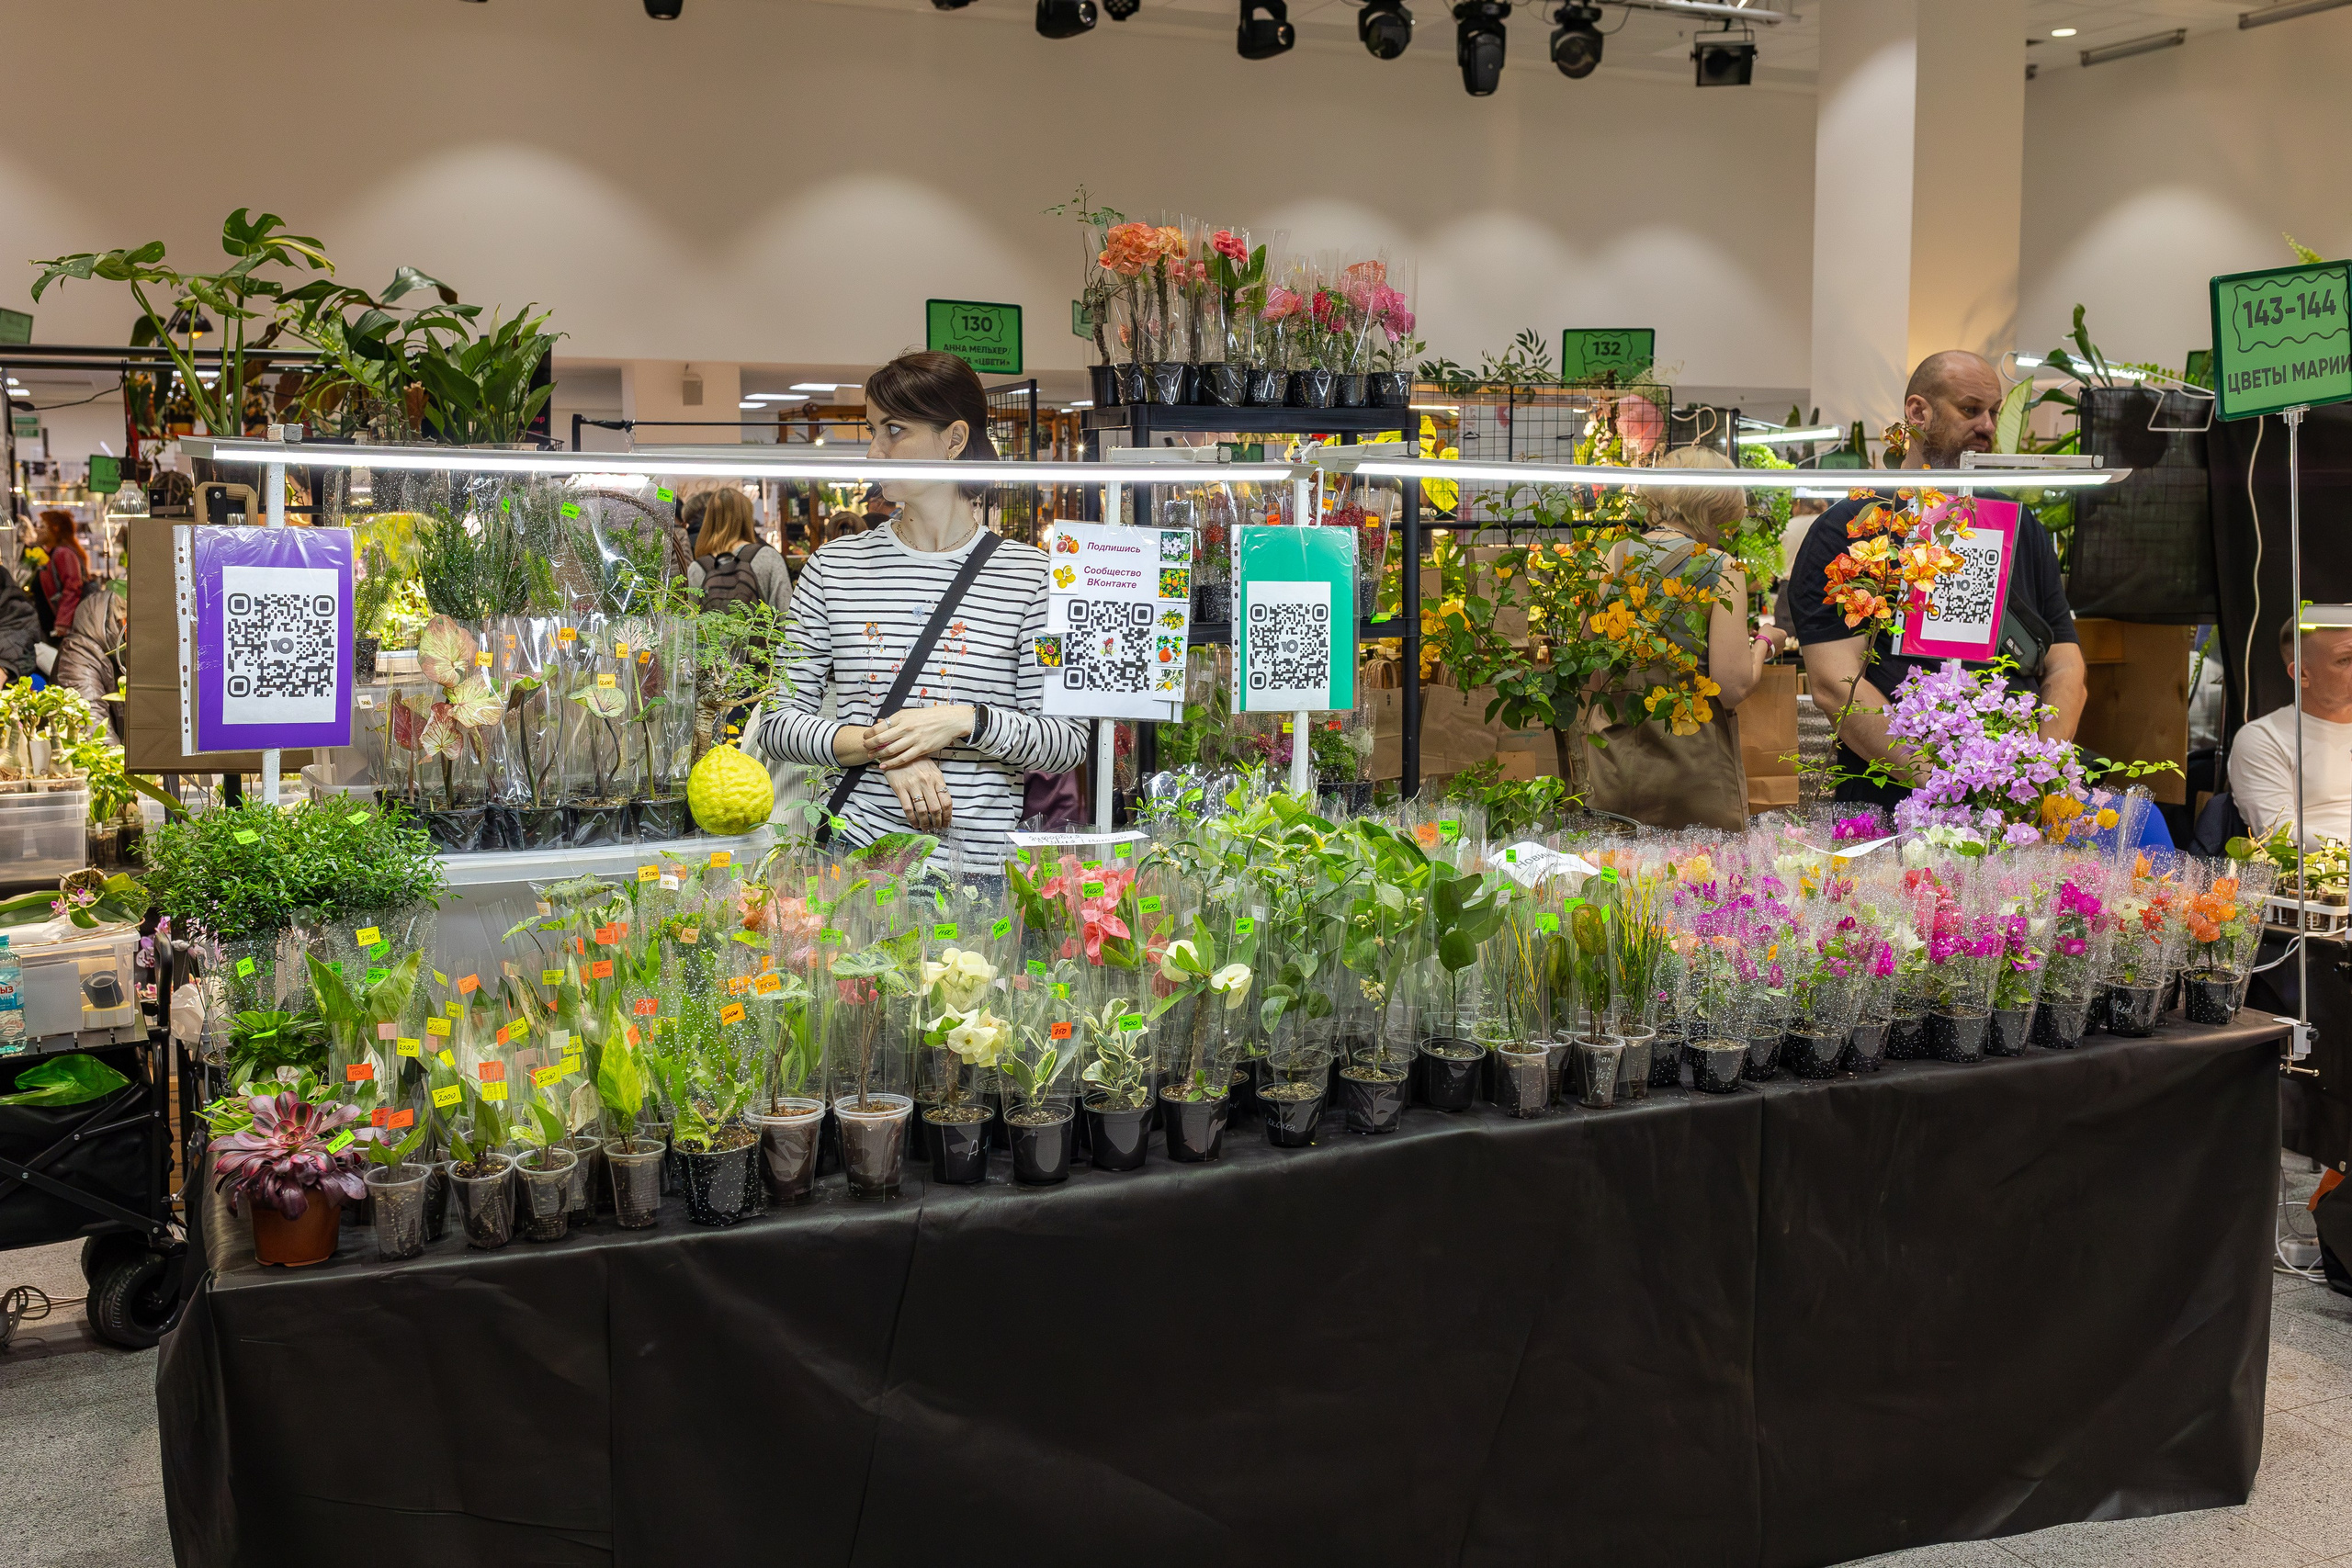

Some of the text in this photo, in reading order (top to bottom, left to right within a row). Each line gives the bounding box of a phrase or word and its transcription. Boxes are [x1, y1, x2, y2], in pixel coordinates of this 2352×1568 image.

[2243, 288, 2336, 329] 143-144
[961, 315, 993, 332] 130
[943, 344, 967, 352] АННА
[1593, 342, 1621, 355] 132
[2227, 354, 2352, 395] ЦВЕТЫ МАРИИ
[1087, 542, 1141, 554] Подпишись
[1083, 565, 1142, 578] Сообщество
[1087, 578, 1137, 589] ВКонтакте
[360, 933, 376, 942] 3000
[428, 1024, 447, 1033] 2500
[437, 1093, 457, 1102] 2000
